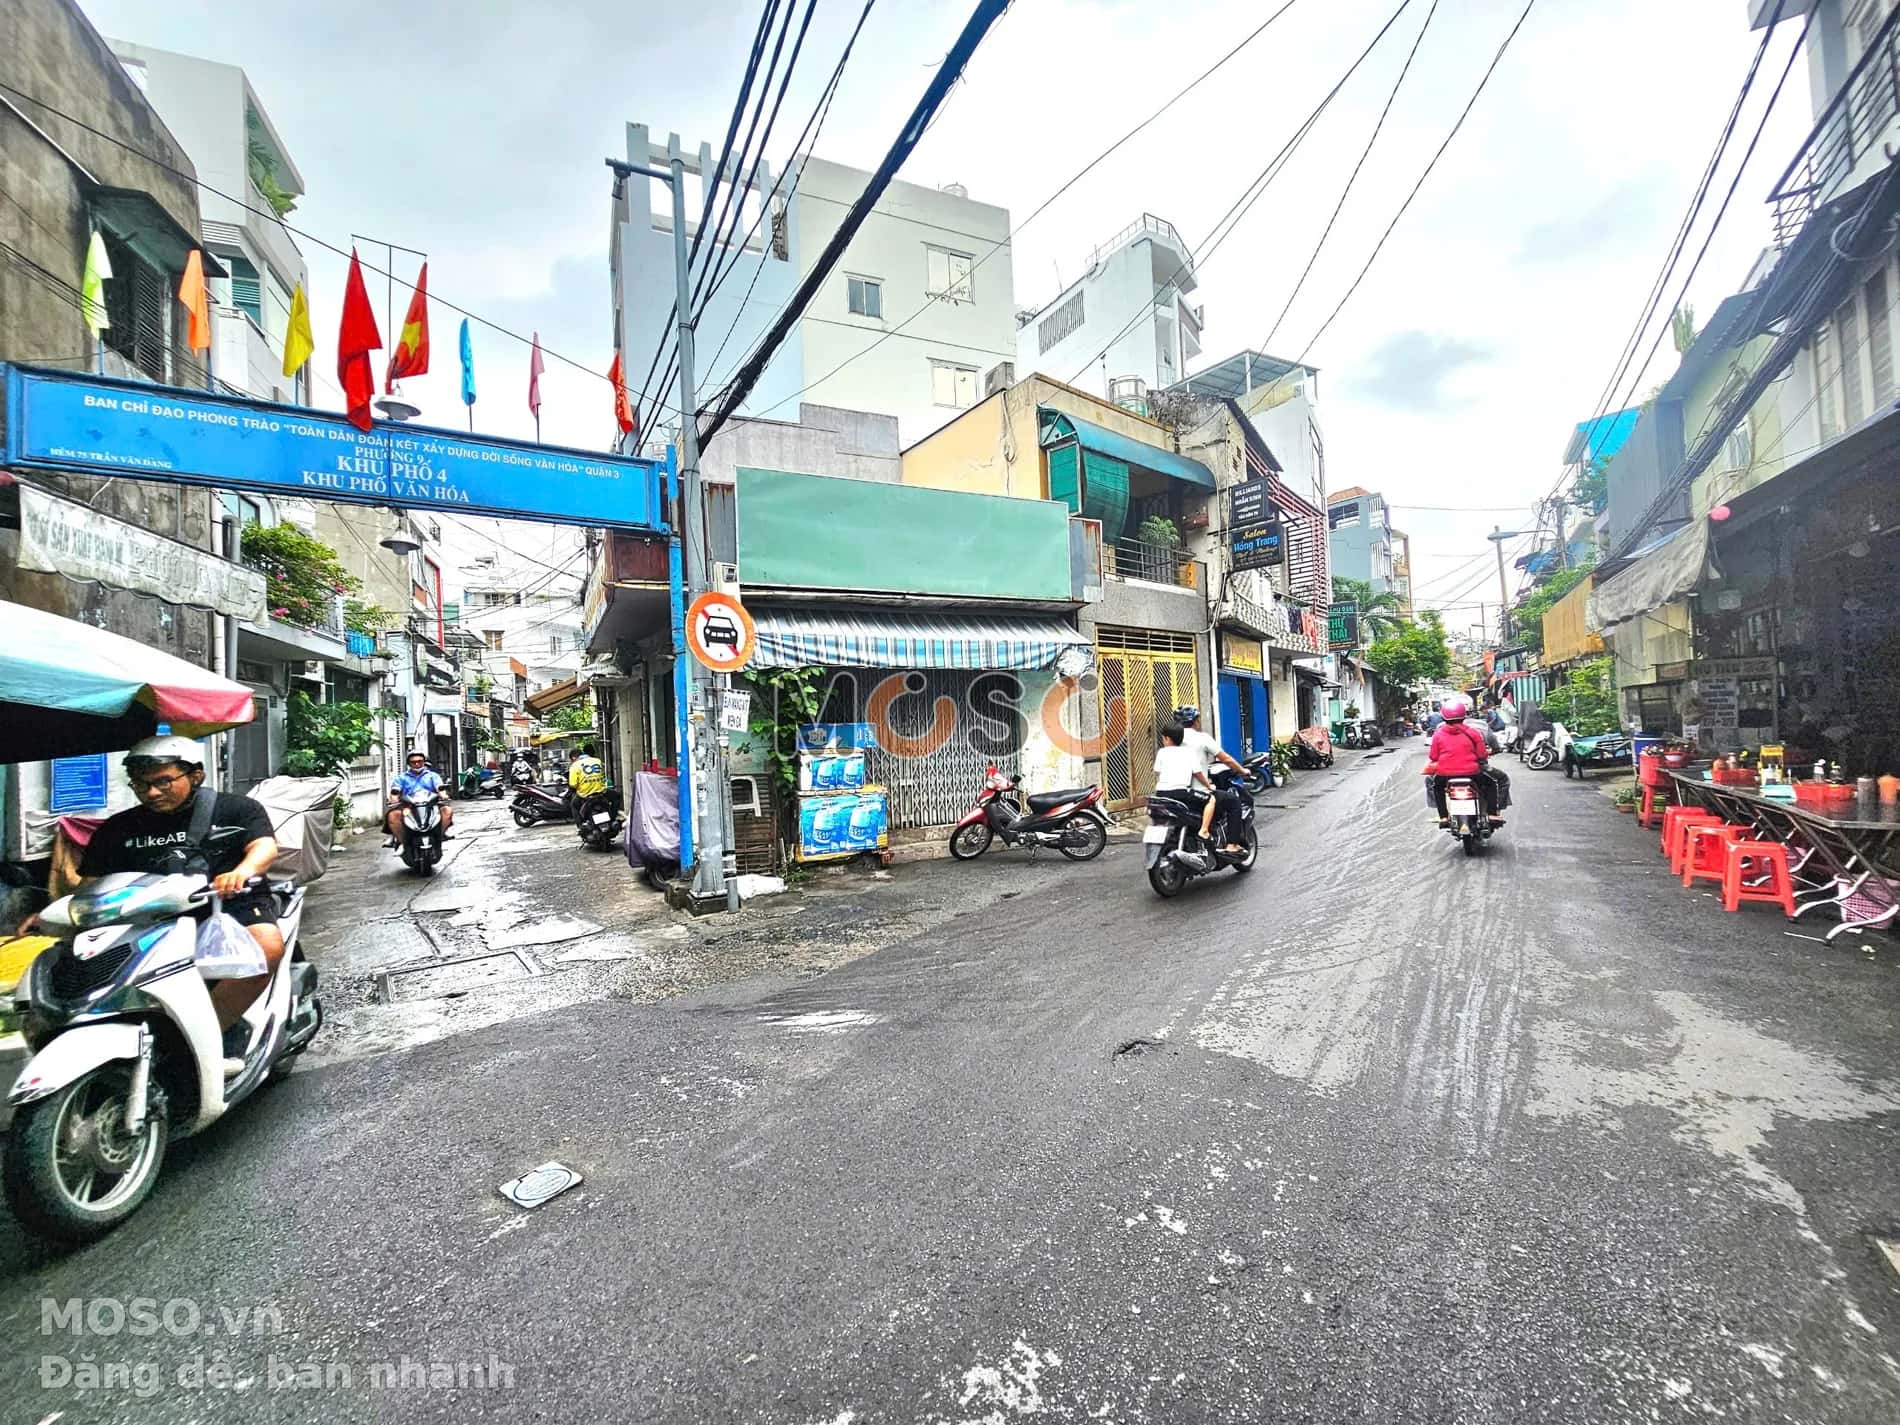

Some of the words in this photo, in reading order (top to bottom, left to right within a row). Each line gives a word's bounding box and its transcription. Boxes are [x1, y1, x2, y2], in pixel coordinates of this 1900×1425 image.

[84, 395, 117, 410] BAN
[188, 409, 238, 427] PHONG
[242, 415, 280, 432] TRÀO
[328, 428, 355, 442] DÂN
[358, 434, 393, 449] ĐOÀN
[396, 437, 419, 451] KẾT
[482, 447, 500, 462] ĐỜI
[503, 451, 532, 467] SỐNG
[613, 470, 620, 479] 3
[337, 455, 384, 475] KHU
[391, 459, 433, 481] PHỐ
[436, 468, 448, 483] 4
[302, 470, 344, 488] KHU
[350, 474, 388, 494] PHỐ
[394, 480, 429, 498] VĂN
[434, 484, 470, 503] HÓA
[1243, 529, 1267, 540] Salon
[1256, 535, 1278, 548] Trang
